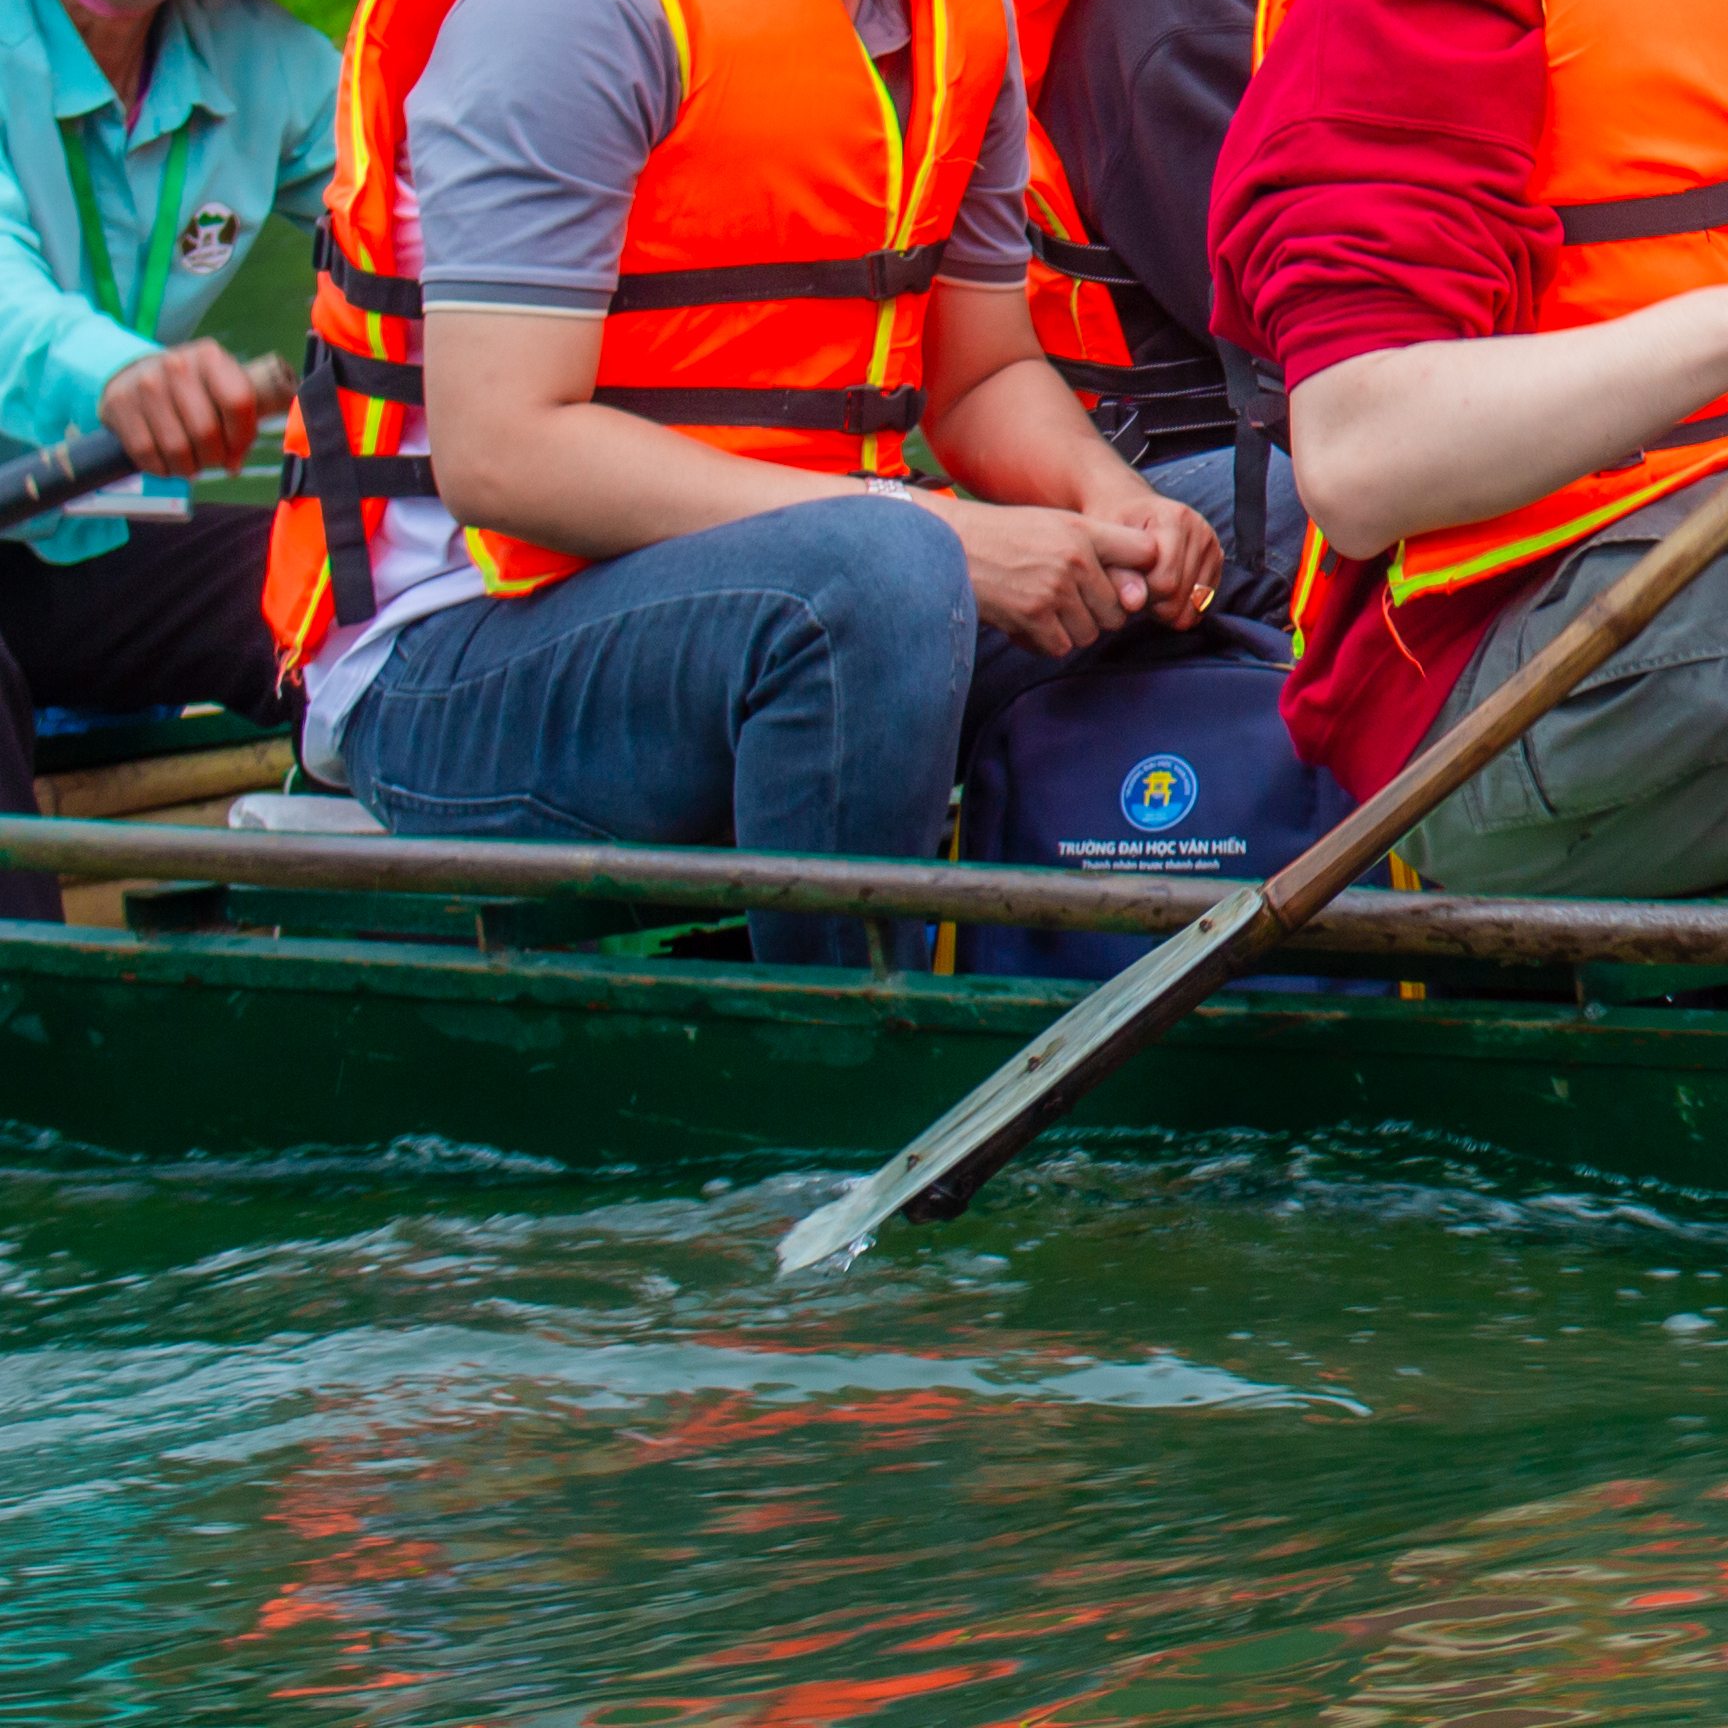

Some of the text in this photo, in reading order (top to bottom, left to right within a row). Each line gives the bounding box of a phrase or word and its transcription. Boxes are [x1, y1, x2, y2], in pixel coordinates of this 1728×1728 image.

[1058, 838, 1116, 856] TRƯỜNG
[1118, 840, 1143, 858] ĐẠI
[1145, 840, 1177, 857] HỌC
